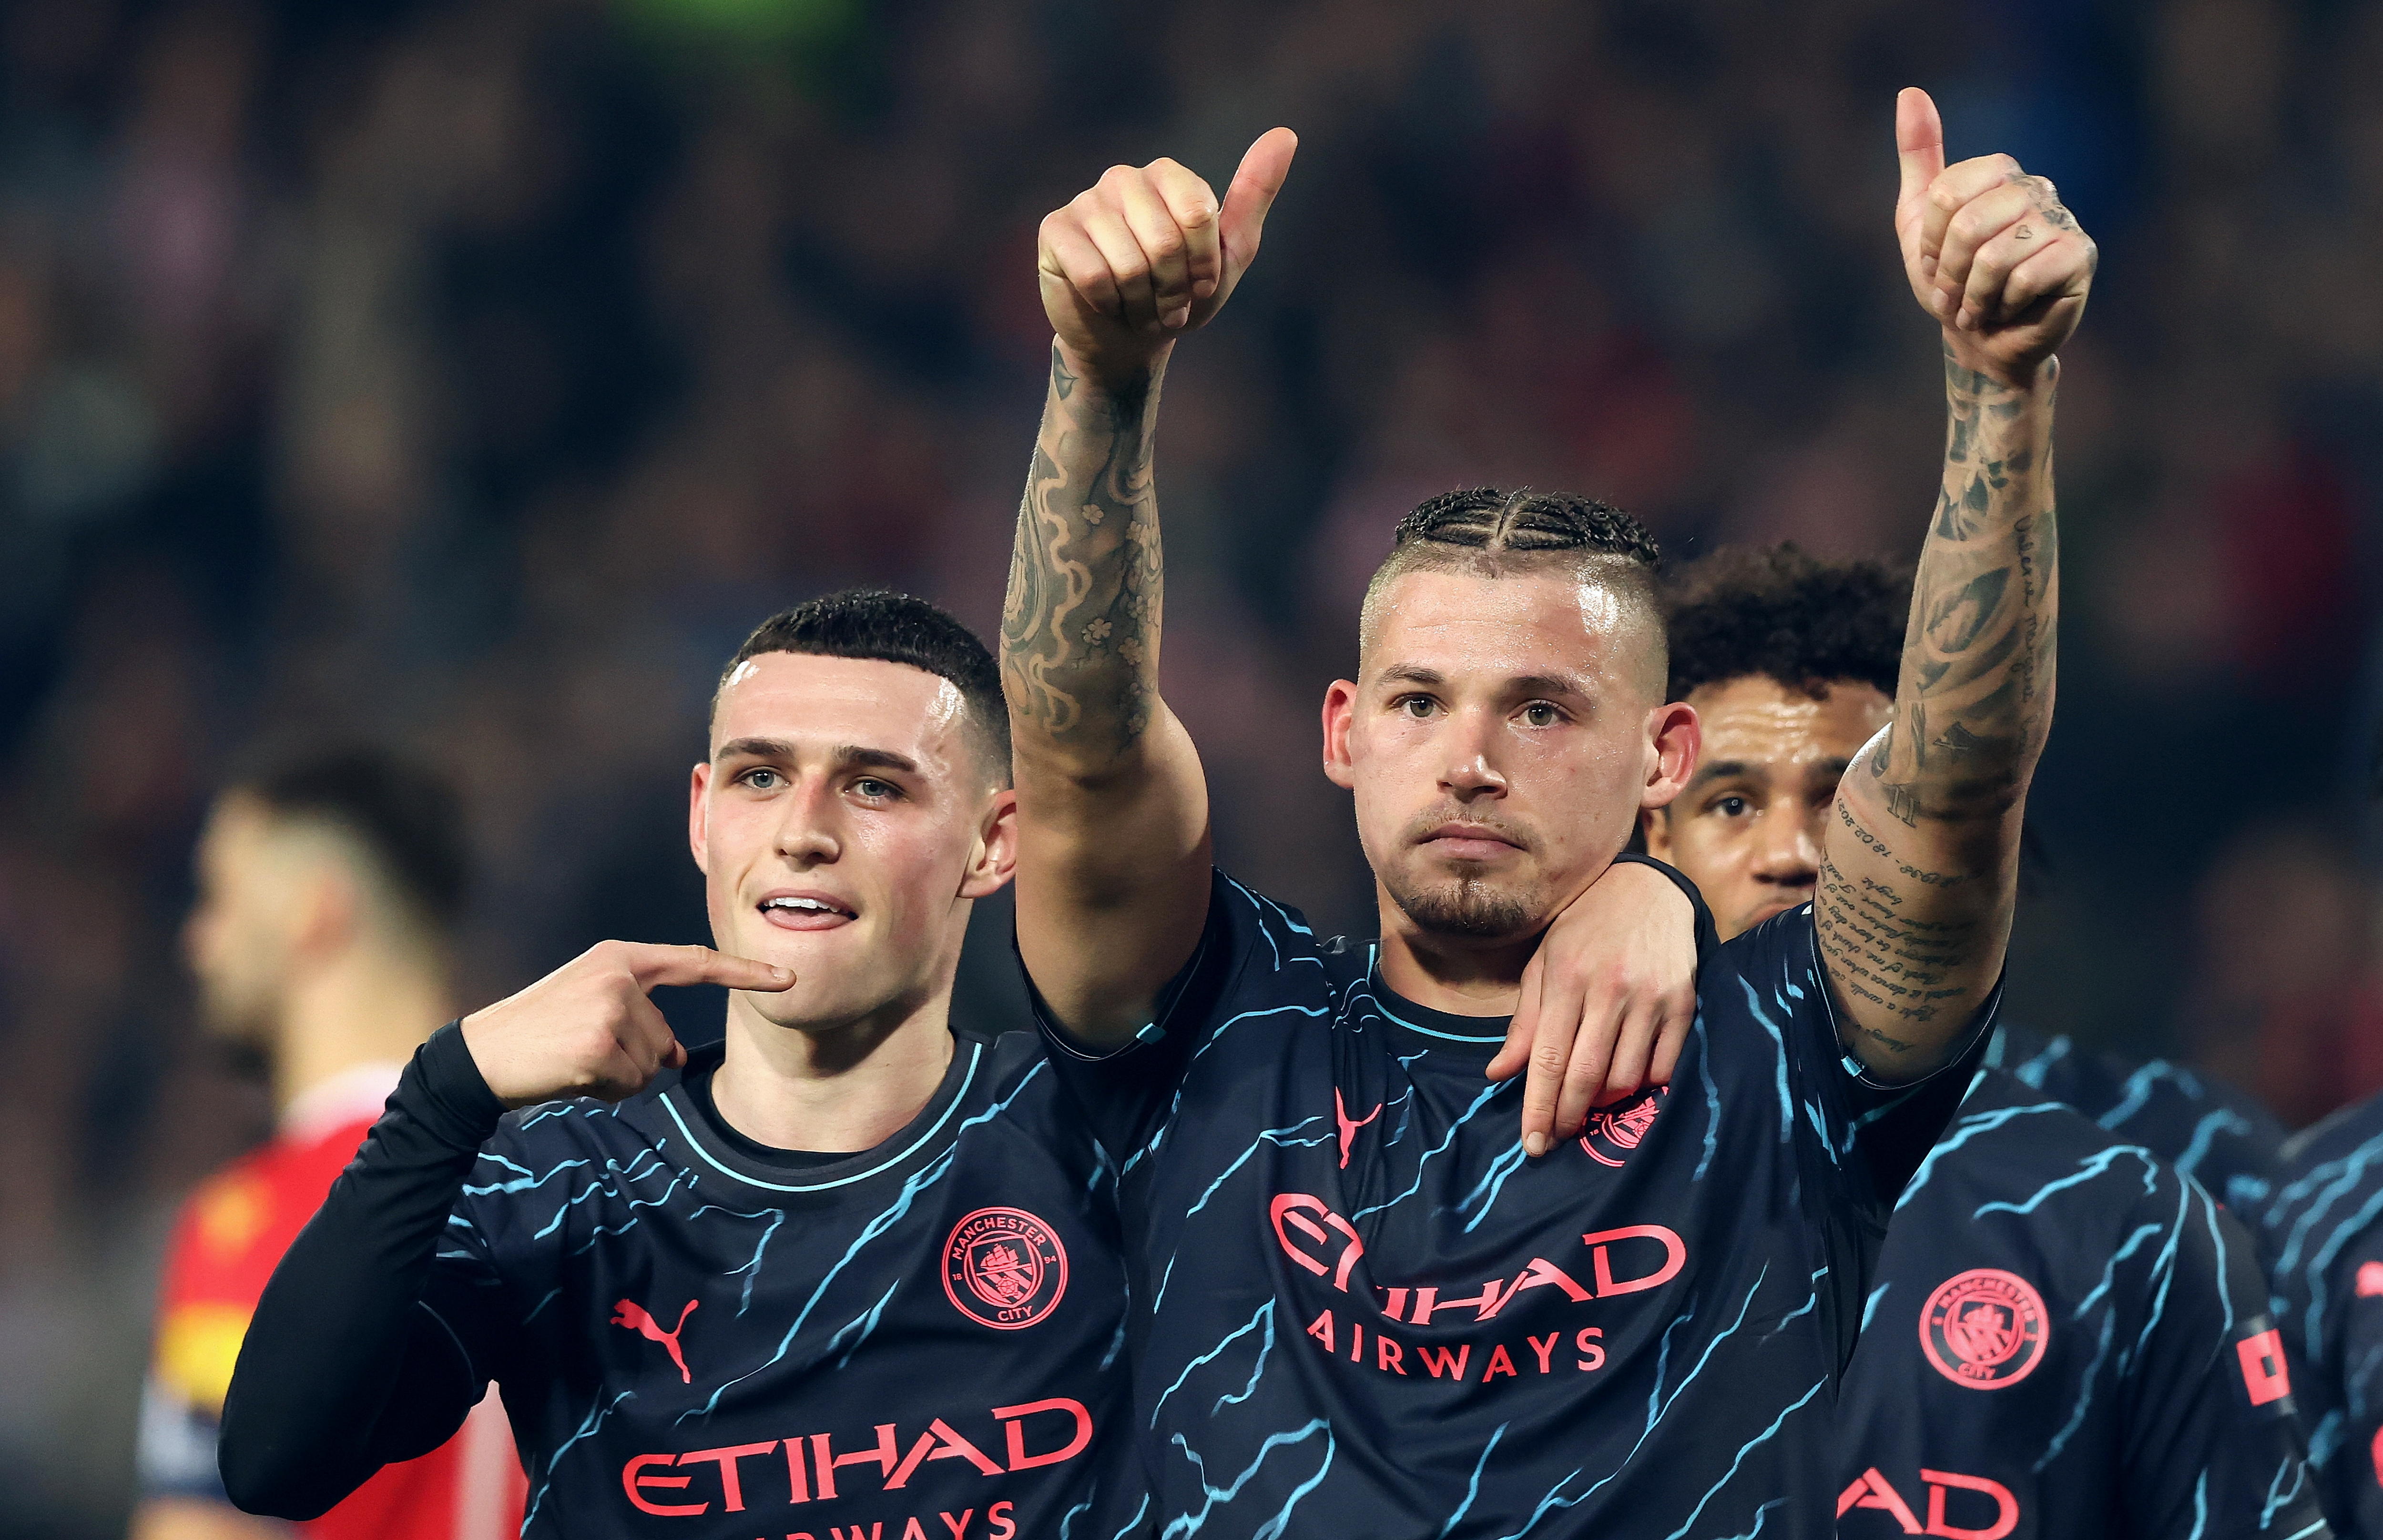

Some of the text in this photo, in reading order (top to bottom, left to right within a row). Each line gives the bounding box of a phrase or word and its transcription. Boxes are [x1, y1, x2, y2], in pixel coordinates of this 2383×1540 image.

[952, 1216, 1047, 1261] MANCHESTER
[1044, 1256, 1057, 1265] 94
[1270, 1193, 1687, 1326] ETIHAD
[997, 1305, 1033, 1322] CITY
[1306, 1309, 1607, 1383] AIRWAYS
[621, 1397, 1094, 1517] ETIHAD
